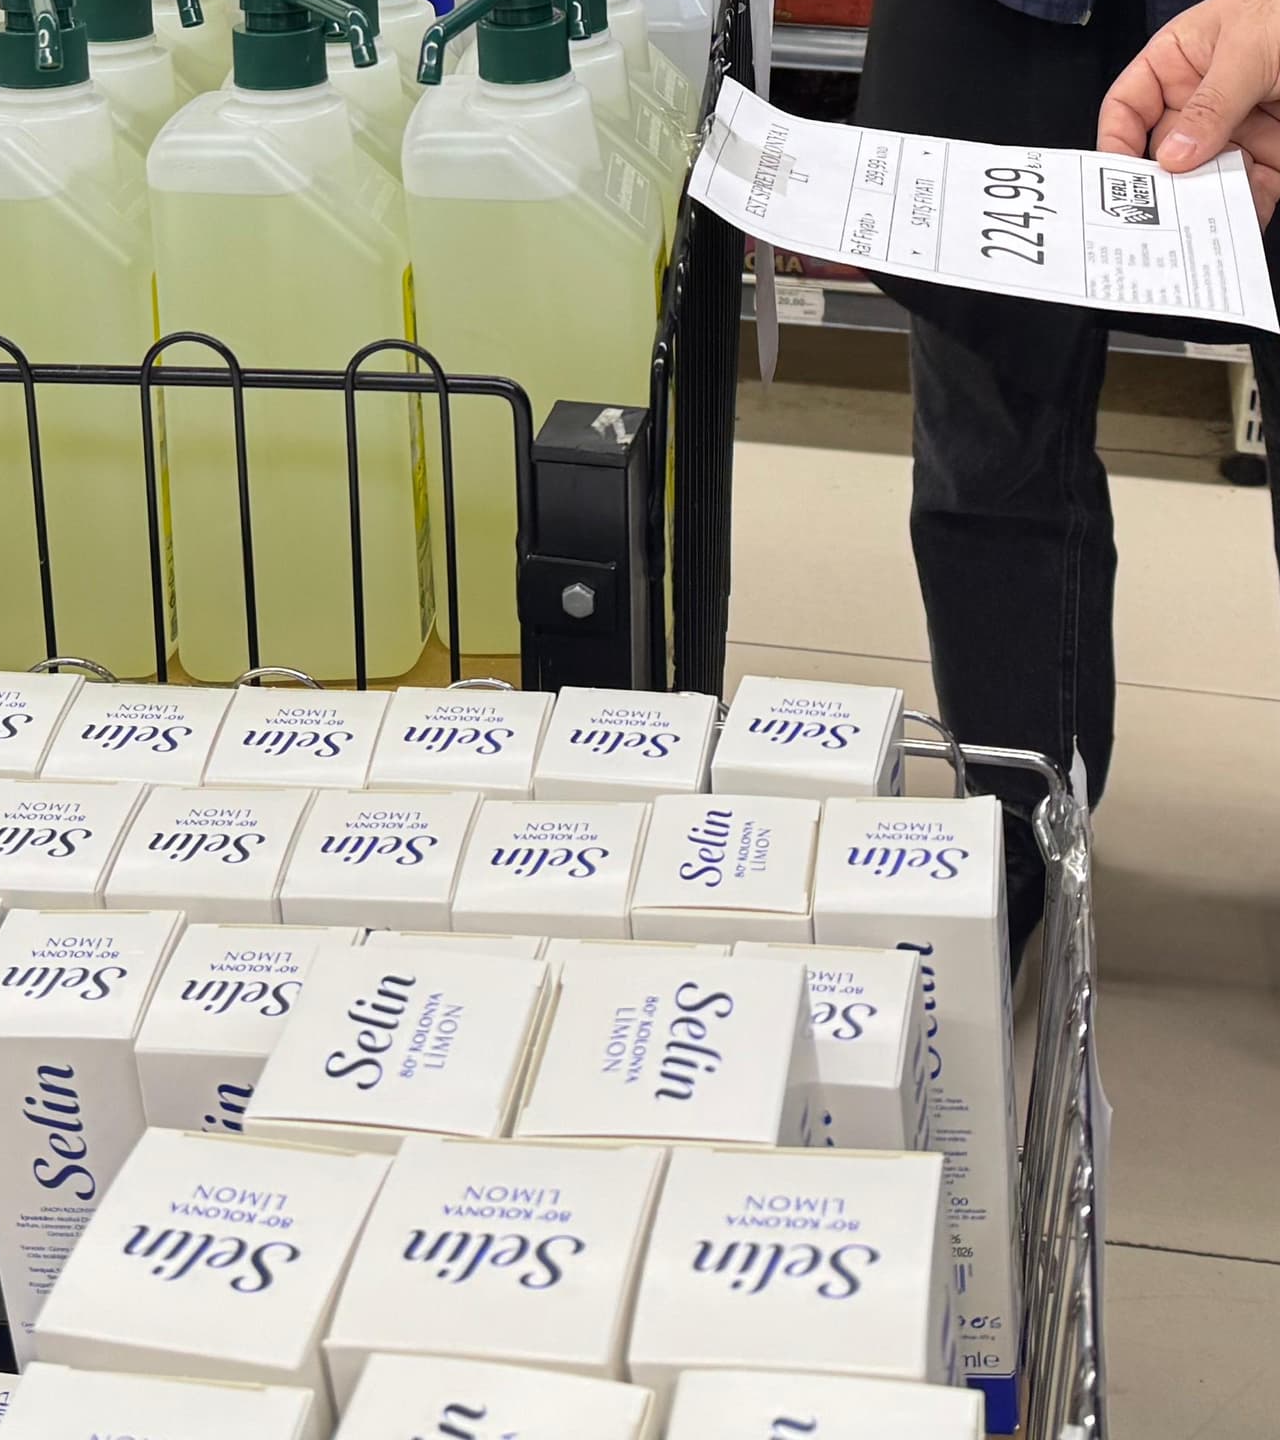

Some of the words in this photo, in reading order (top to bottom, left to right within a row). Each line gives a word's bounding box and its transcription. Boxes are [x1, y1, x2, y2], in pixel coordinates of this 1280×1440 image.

[1108, 177, 1127, 202] YERLİ
[1129, 175, 1149, 205] ÜRETİM
[981, 167, 1057, 265] 224,99
[82, 724, 192, 752] Selin
[243, 731, 353, 757] Selin
[404, 727, 514, 754] Selin
[570, 723, 680, 757] Selin
[749, 718, 860, 748] Selin
[149, 833, 265, 863] Selin
[321, 836, 437, 865] Selin
[491, 848, 609, 877] Selin
[680, 811, 732, 887] Selin
[848, 847, 968, 878] Selin
[2, 967, 127, 1000] Selin
[181, 980, 302, 1016] Selin
[326, 976, 419, 1090] Selin
[430, 1002, 465, 1069] LİMON
[600, 1004, 622, 1073] LİMON
[651, 982, 732, 1100] Selin
[27, 1066, 95, 1200] Selin
[189, 1185, 288, 1210] LİMON
[464, 1185, 562, 1207] LİMON
[745, 1193, 845, 1213] LİMON
[124, 1218, 300, 1292] Selin
[403, 1230, 585, 1288] Selin
[693, 1241, 879, 1297] Selin
